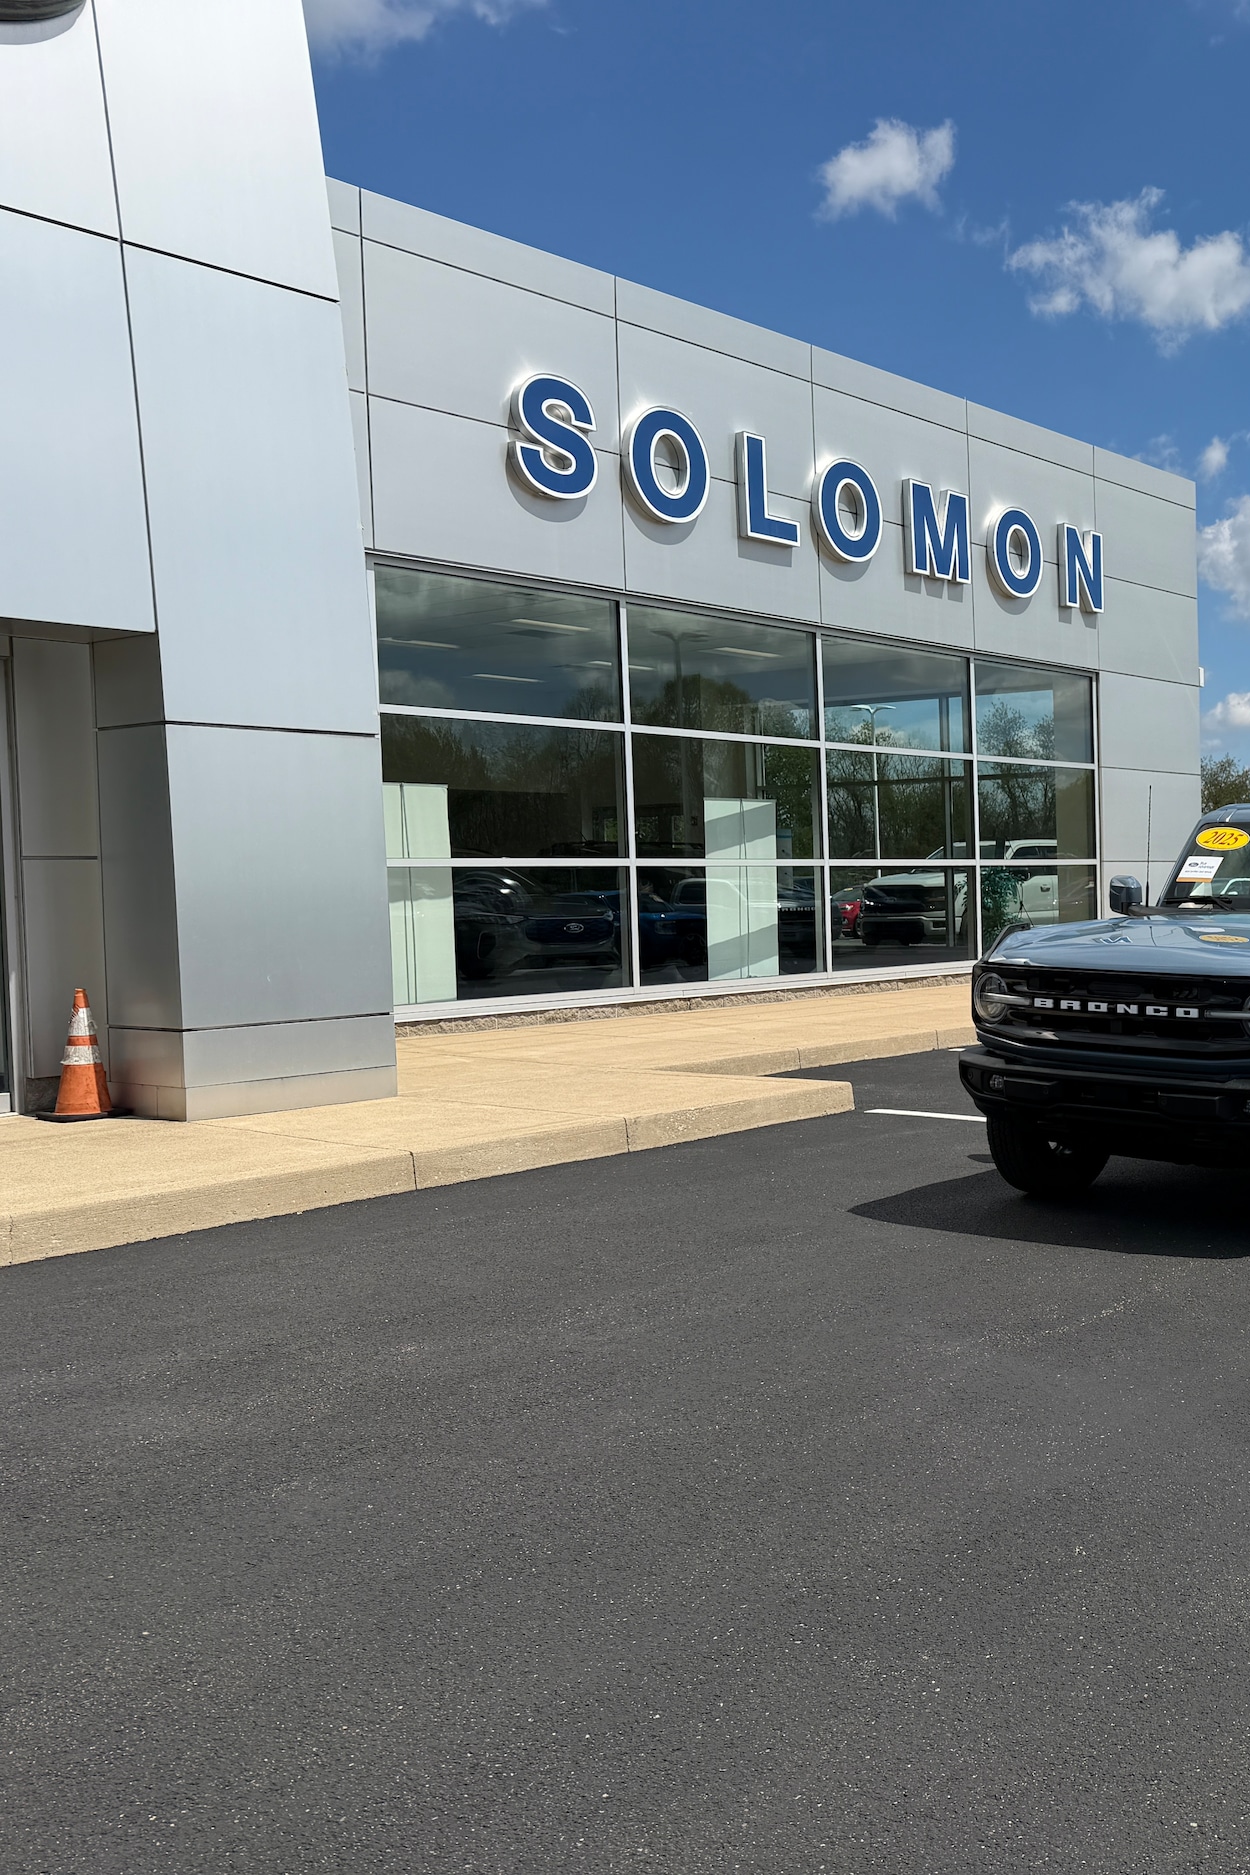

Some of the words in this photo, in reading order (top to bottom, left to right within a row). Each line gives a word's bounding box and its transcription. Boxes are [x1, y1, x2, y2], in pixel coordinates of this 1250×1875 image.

[508, 373, 1104, 613] SOLOMON
[1203, 831, 1244, 846] 2025
[1033, 997, 1199, 1018] BRONCO
